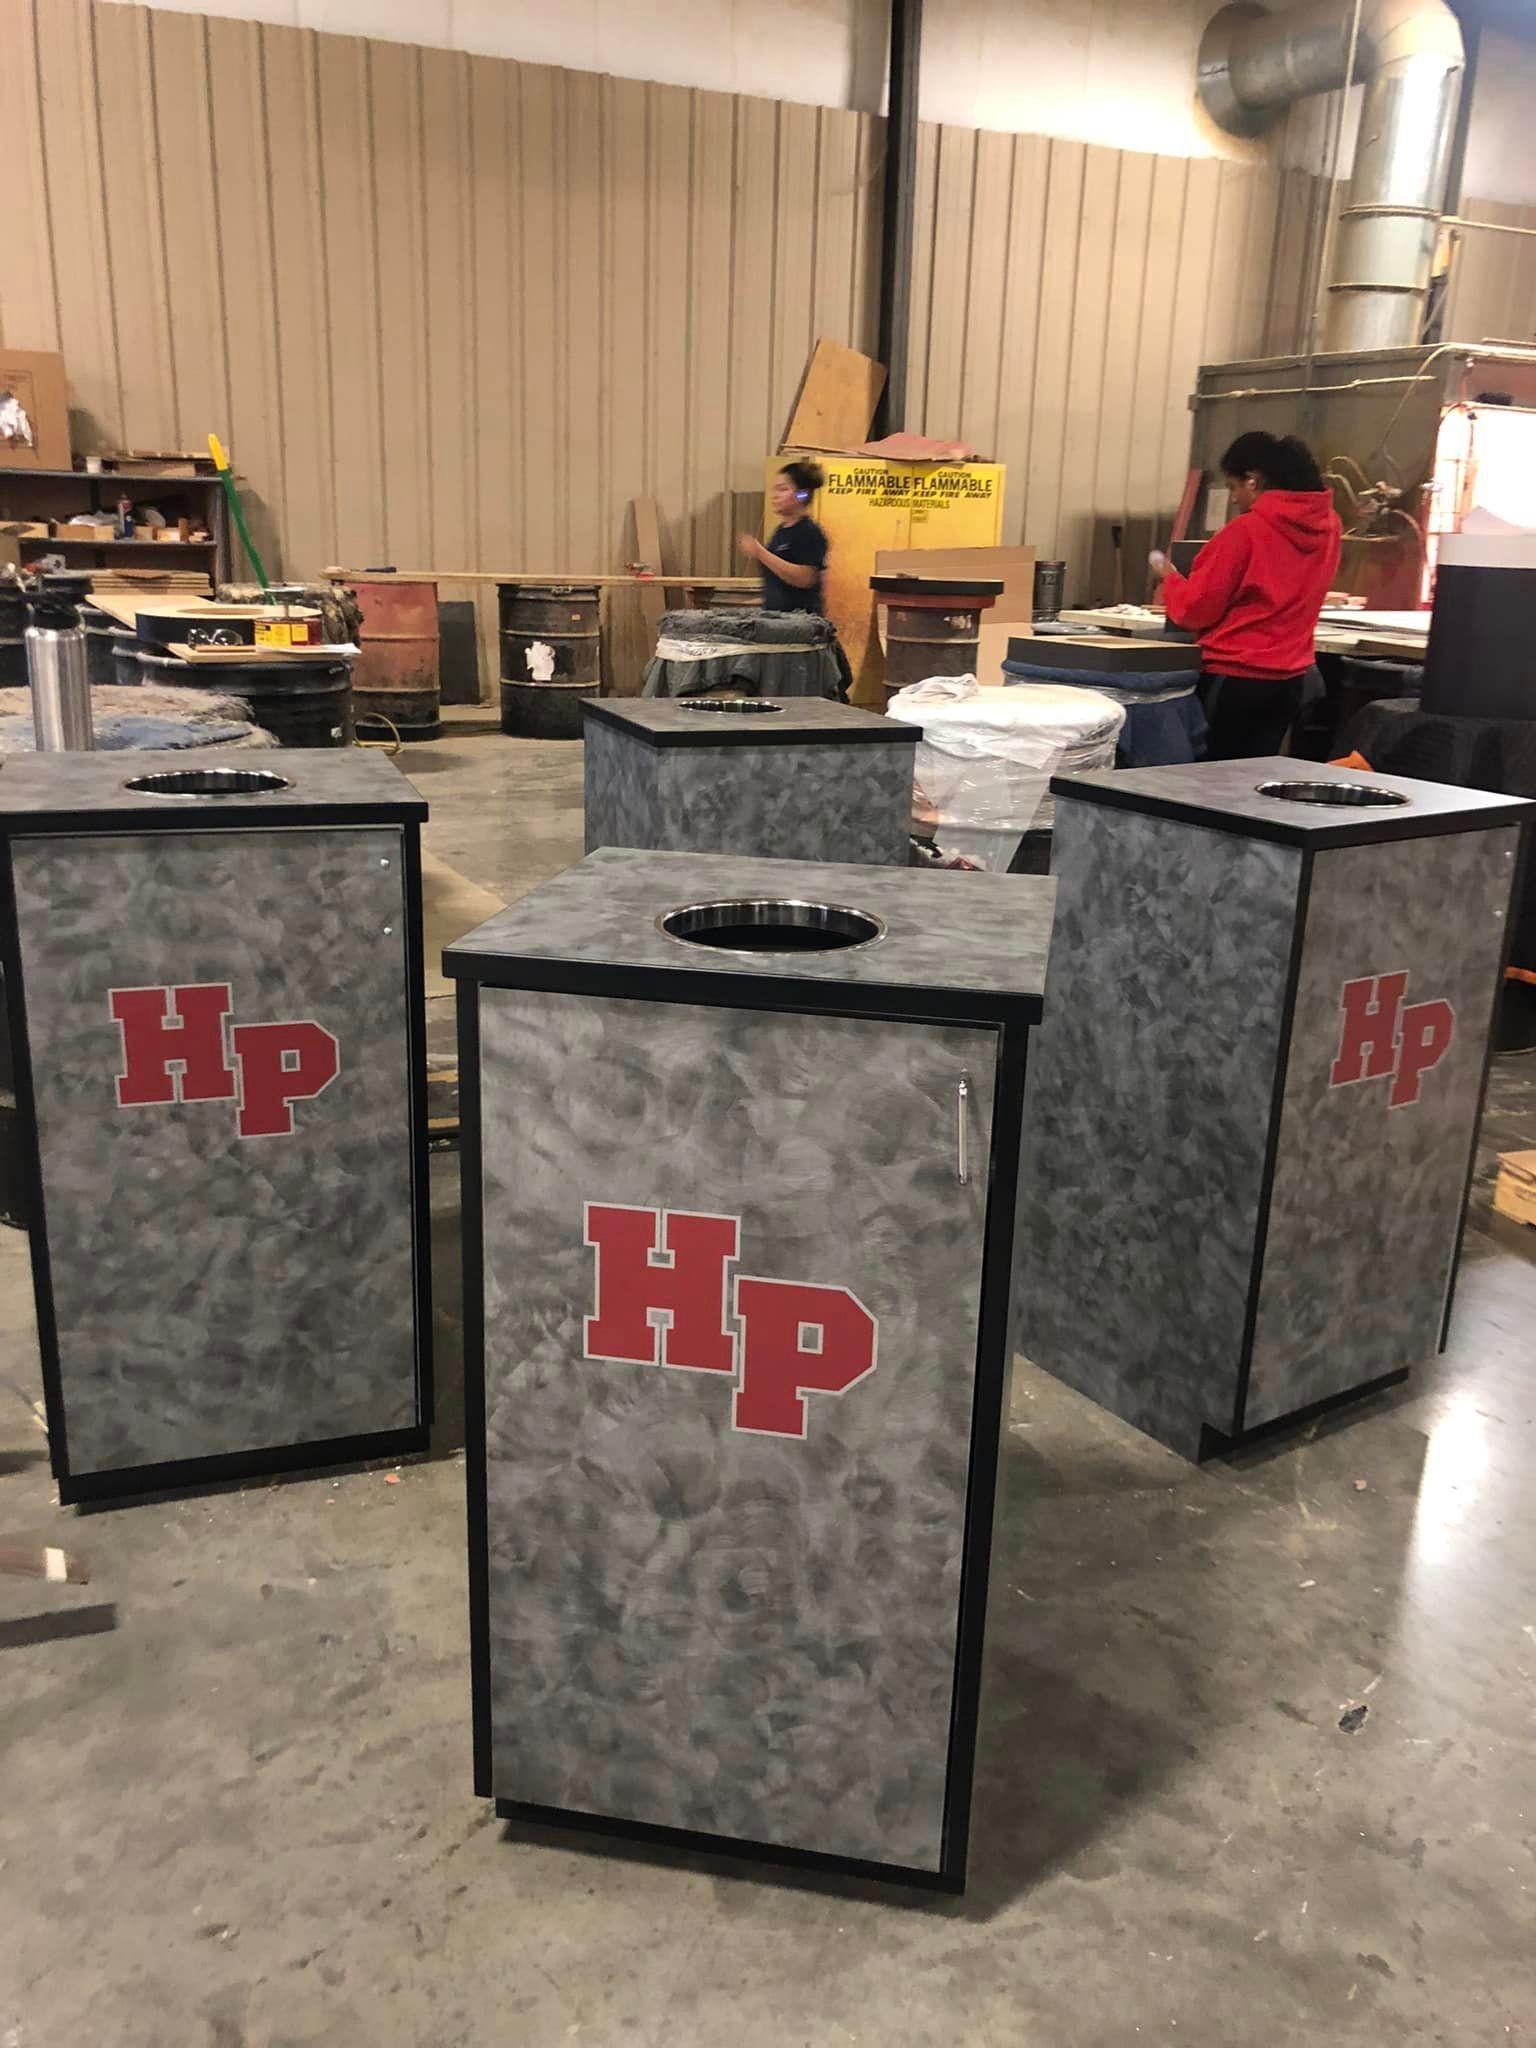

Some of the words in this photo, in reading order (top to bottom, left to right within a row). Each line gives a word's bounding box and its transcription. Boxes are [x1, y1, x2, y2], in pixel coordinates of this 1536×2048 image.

[853, 467, 889, 475] CAUTION
[937, 471, 972, 479] CAUTION
[828, 474, 911, 489] FLAMMABLE
[913, 477, 992, 492] FLAMMABLE
[828, 487, 853, 495] KEEP
[856, 488, 877, 496] FIRE
[882, 489, 910, 497] AWAY
[912, 490, 937, 498] KEEP
[964, 491, 992, 499] AWAY
[869, 497, 911, 508] HAZARDOUS
[912, 498, 950, 509] MATERIALS
[1329, 968, 1456, 1110] HP
[107, 982, 341, 1139] HP
[583, 1201, 879, 1439] HP
